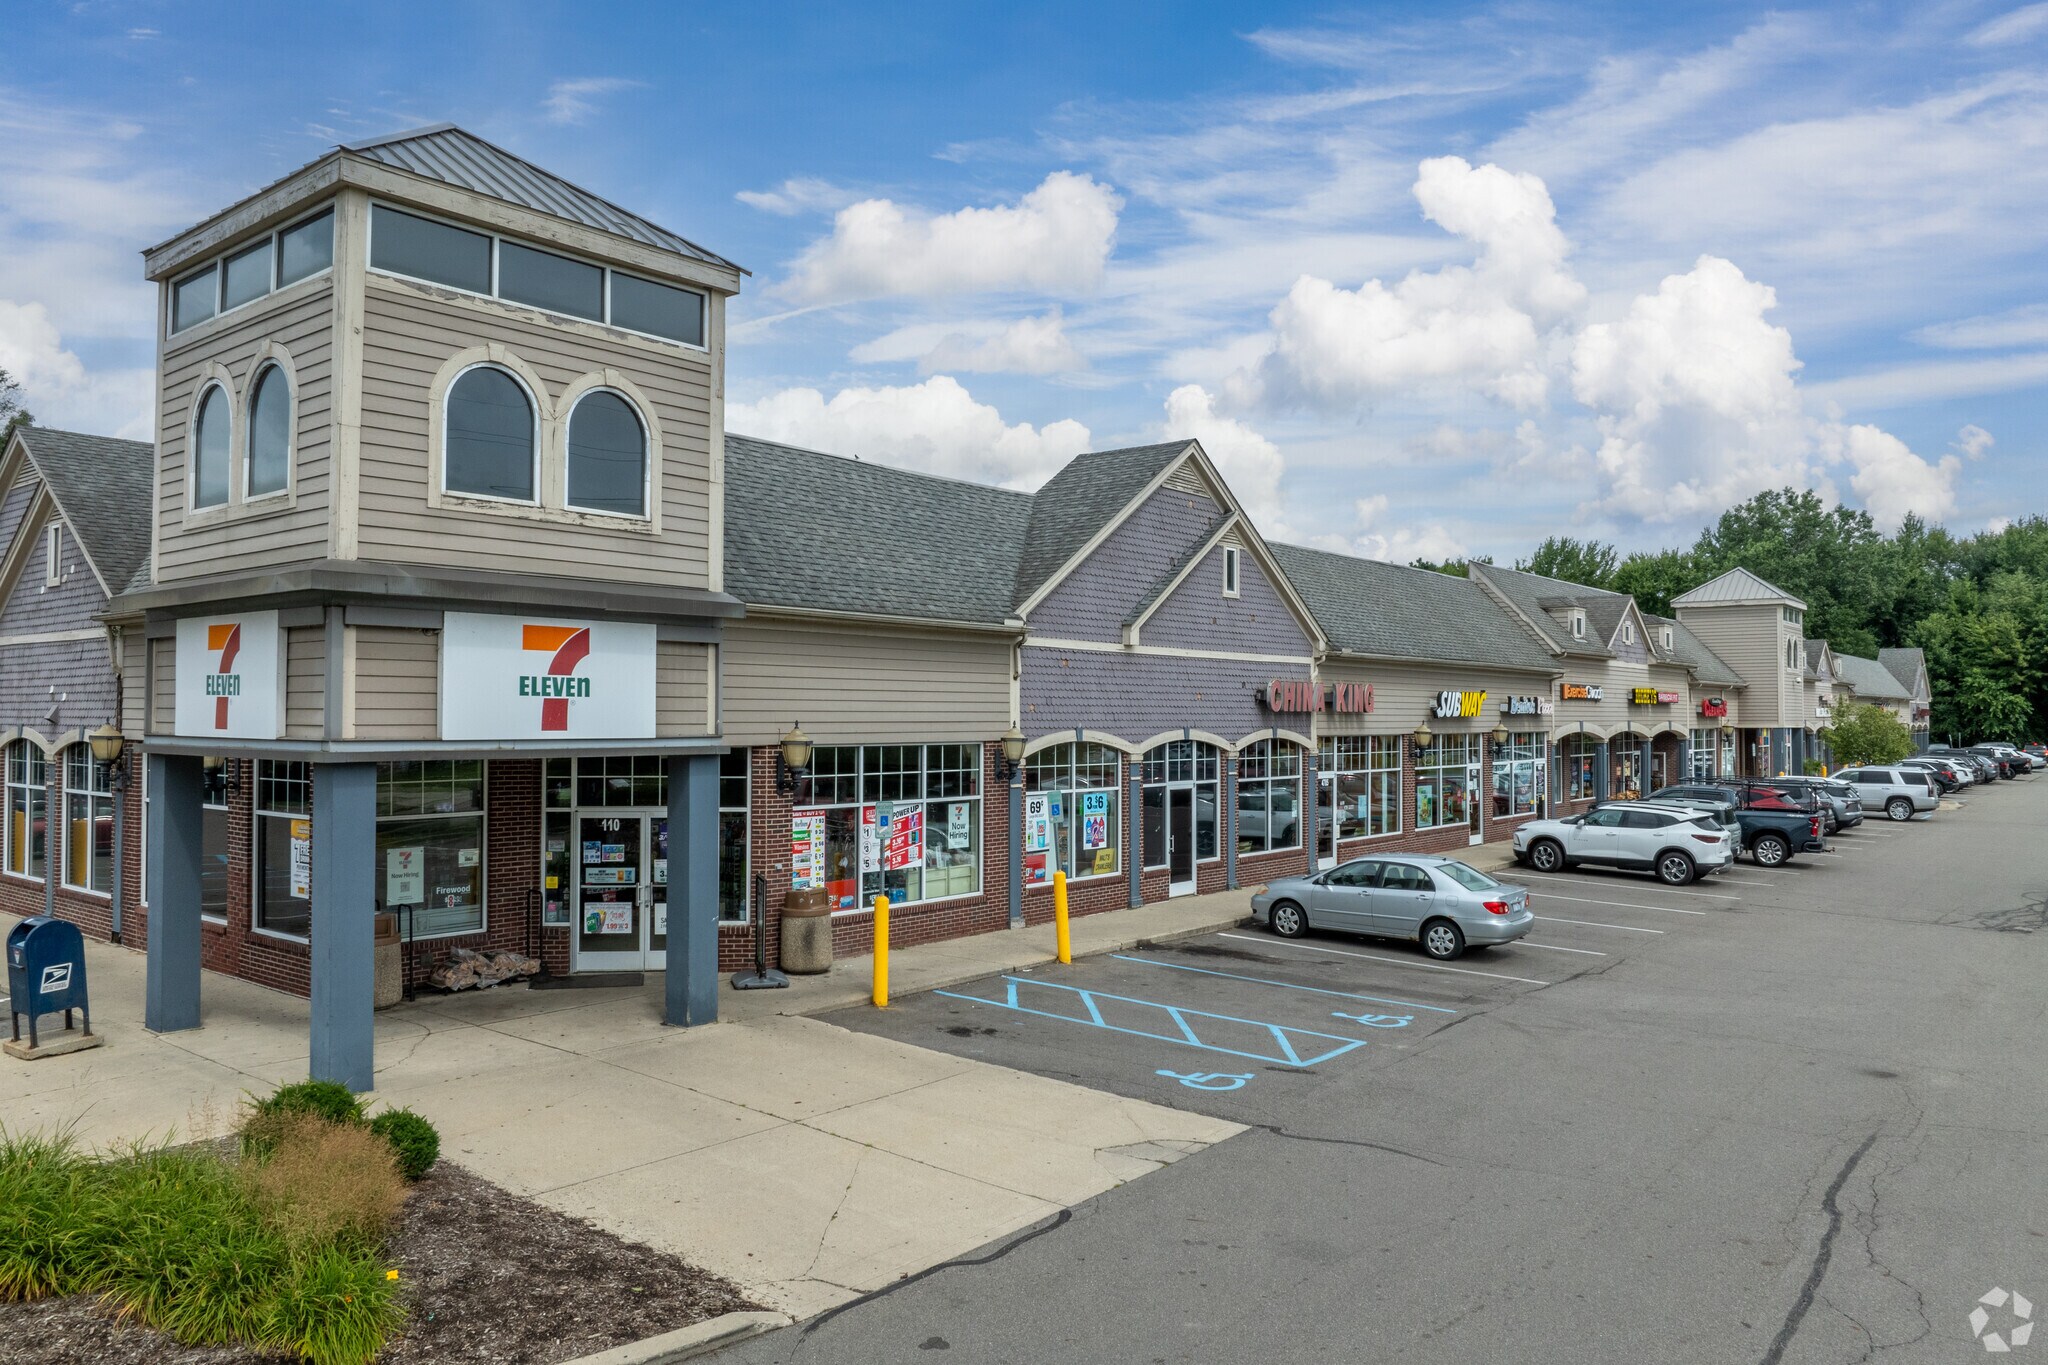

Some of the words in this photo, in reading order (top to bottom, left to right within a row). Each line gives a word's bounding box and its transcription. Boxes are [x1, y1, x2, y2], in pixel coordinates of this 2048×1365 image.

[206, 674, 241, 696] ELEVEN
[208, 622, 241, 730] 7
[522, 624, 590, 731] 7
[519, 675, 591, 698] ELEVEN
[1267, 680, 1326, 713] CHINA
[1334, 682, 1375, 713] KING
[1436, 690, 1488, 718] SUBWAY
[893, 807, 910, 818] POWER
[910, 804, 920, 813] UP
[1087, 796, 1093, 810] 3
[601, 818, 620, 831] 110
[951, 823, 966, 831] Now
[950, 831, 968, 840] Hiring
[436, 885, 471, 895] Firewood
